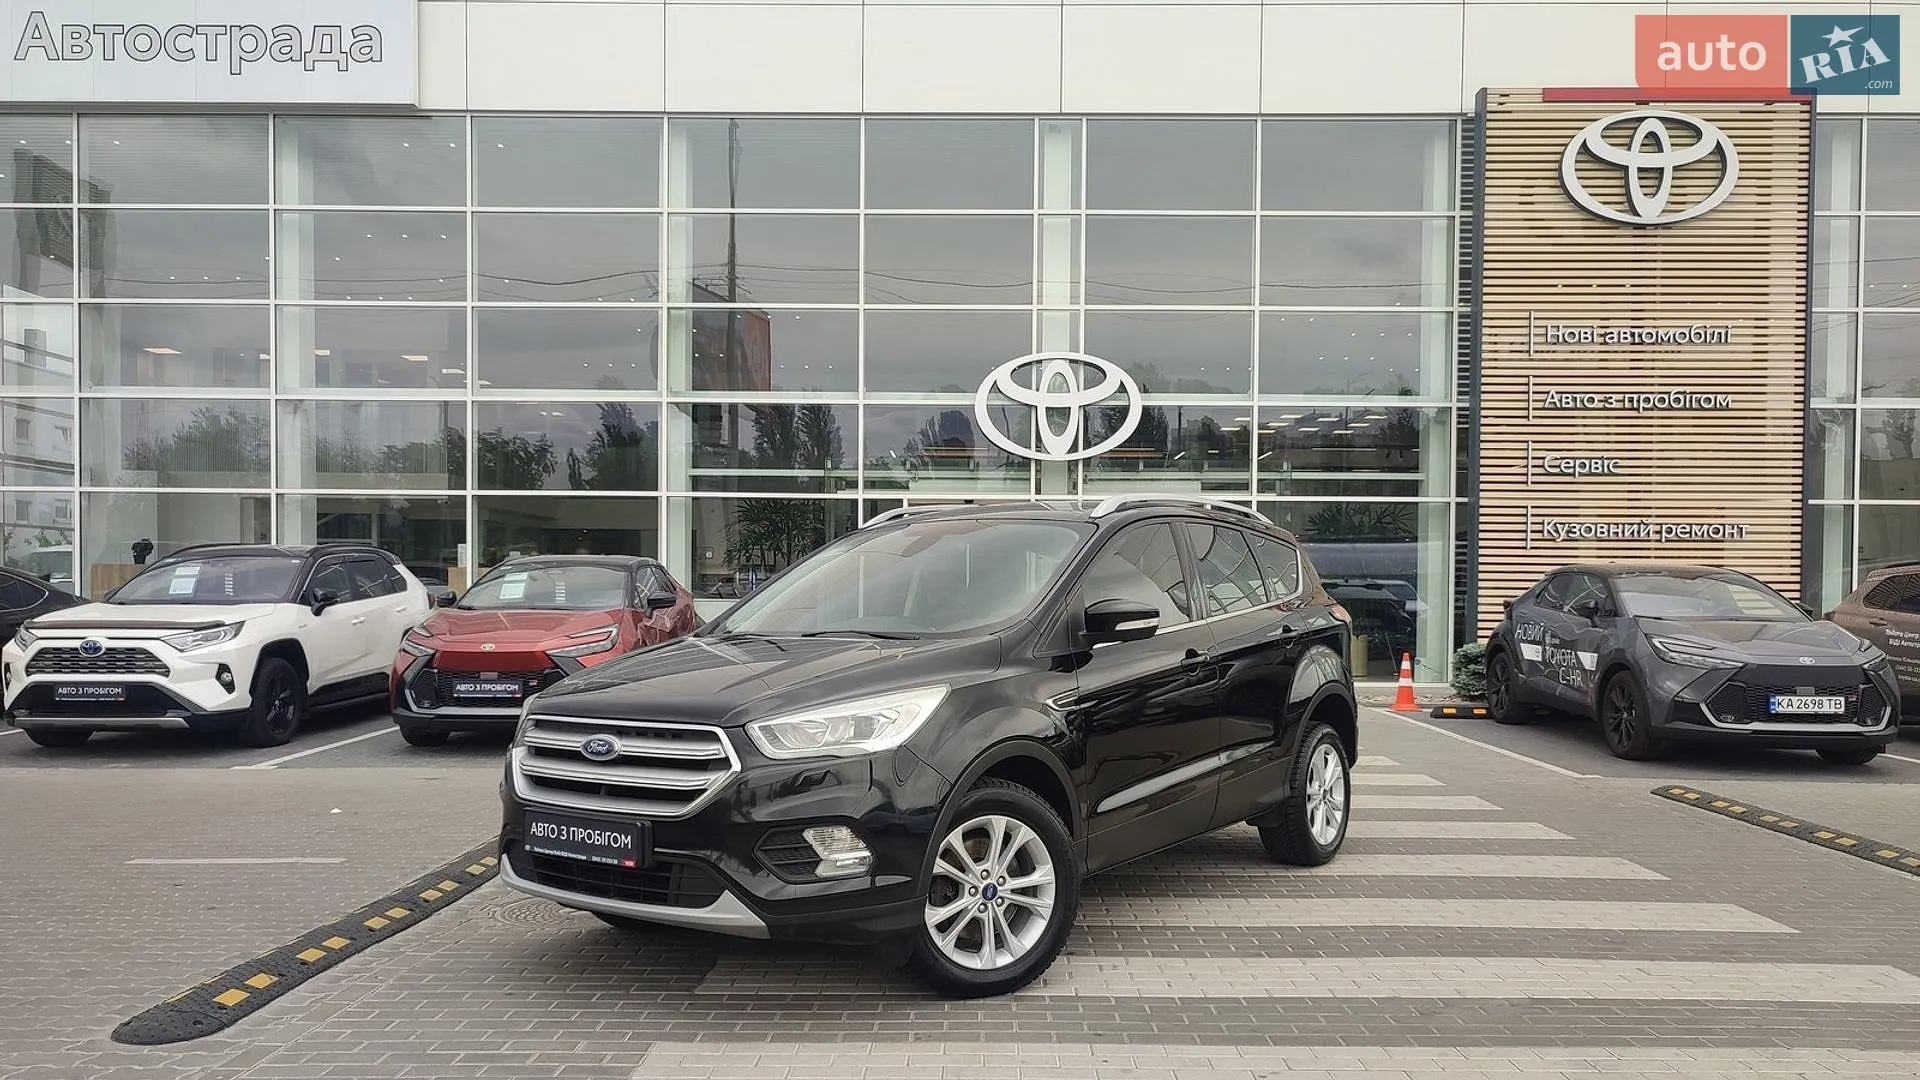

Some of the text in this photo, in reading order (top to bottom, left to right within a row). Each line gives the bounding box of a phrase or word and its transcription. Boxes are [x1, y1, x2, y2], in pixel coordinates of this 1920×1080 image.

[14, 11, 383, 75] Автострада
[1546, 323, 1732, 344] Нові автомобілі
[1544, 388, 1732, 413] Авто з пробігом
[1543, 455, 1620, 478] Сервіс
[1543, 519, 1749, 542] Кузовний ремонт
[1515, 621, 1544, 641] НОВИЙ
[1545, 647, 1577, 668] TOYOTA
[1559, 667, 1584, 687] C-HR
[1777, 699, 1793, 709] KA
[1796, 699, 1824, 709] 2698
[530, 822, 632, 849] АВТО З ПРОБІГОМ
